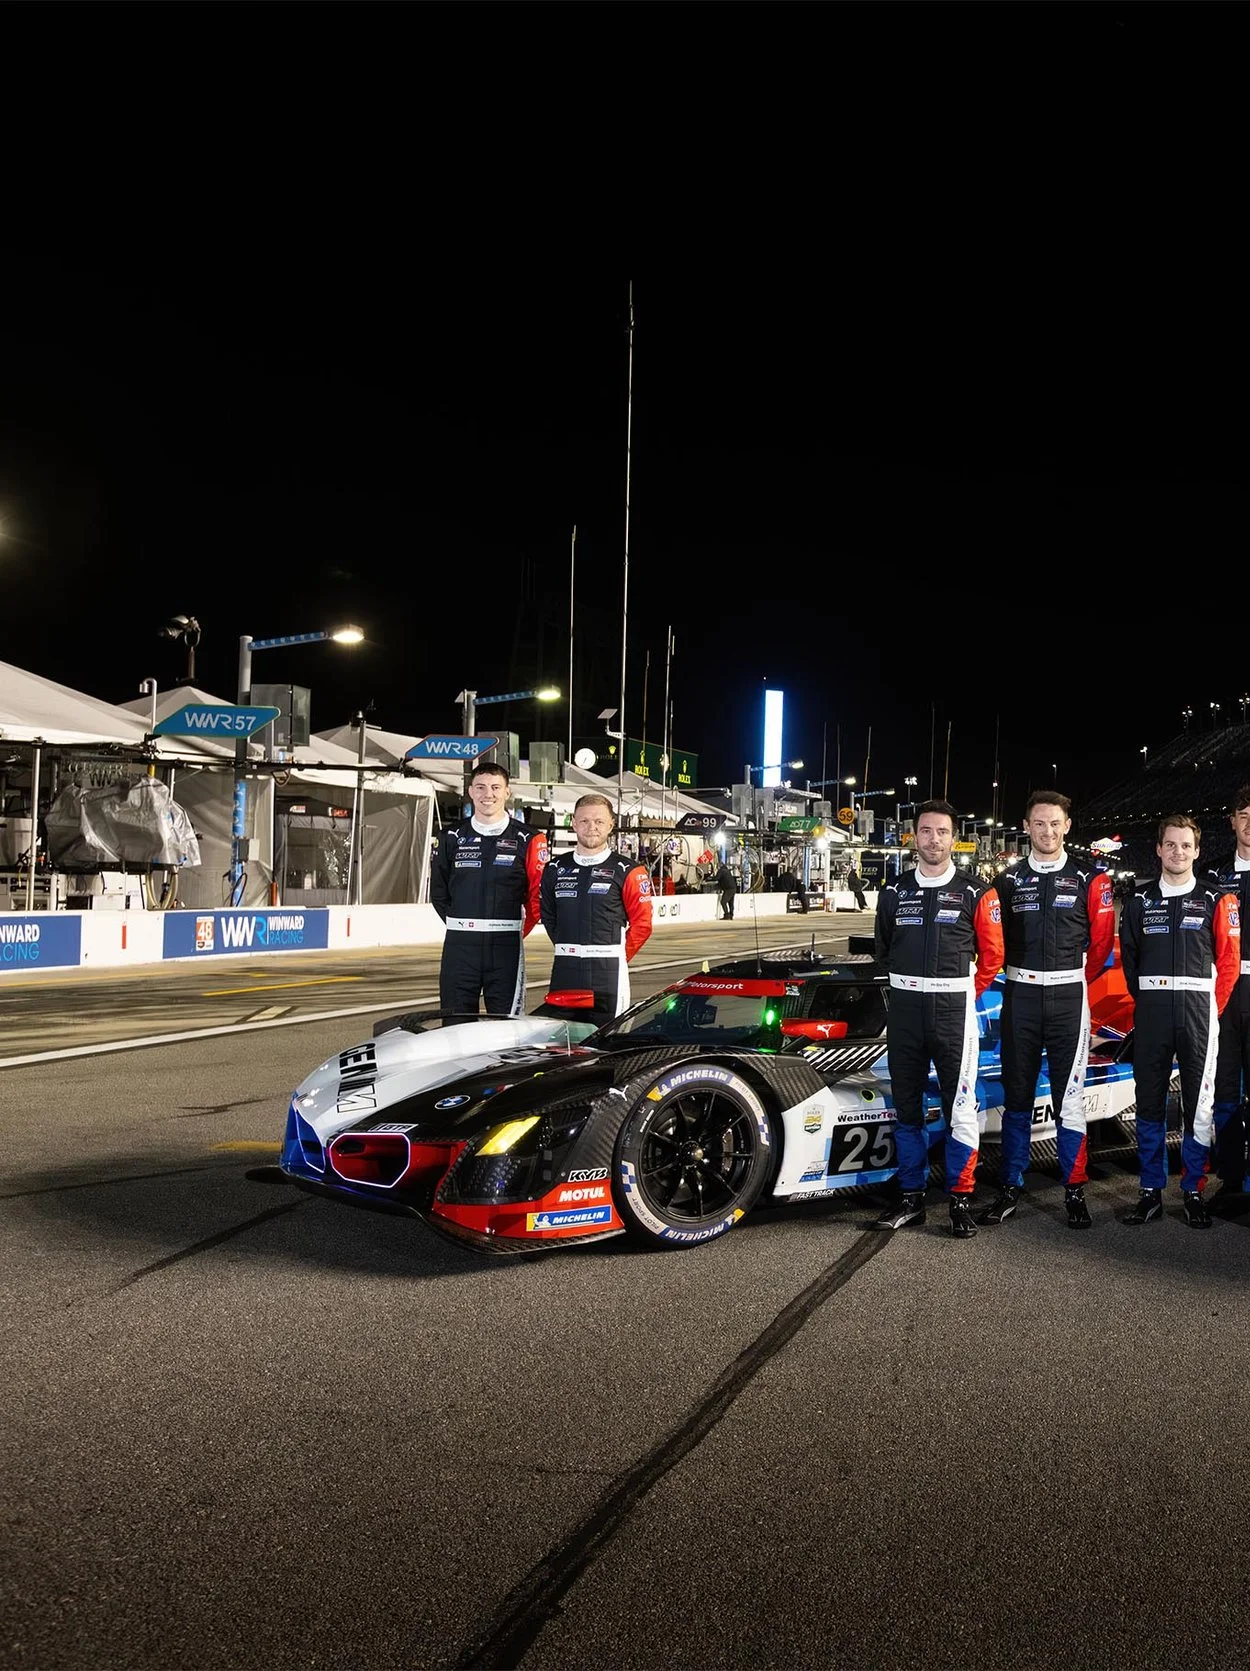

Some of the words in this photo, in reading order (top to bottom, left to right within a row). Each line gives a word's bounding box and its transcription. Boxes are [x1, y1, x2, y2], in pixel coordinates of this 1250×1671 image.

[234, 716, 256, 731] 57
[462, 743, 479, 755] 48
[677, 773, 692, 785] ROLEX
[702, 817, 717, 828] 99
[839, 810, 854, 822] 59
[800, 820, 812, 829] 77
[268, 915, 305, 931] WINWARD
[197, 922, 213, 941] 48
[269, 930, 304, 945] RACING
[670, 1069, 728, 1087] MICHELIN
[1032, 1104, 1056, 1125] EN
[838, 1125, 894, 1172] 25
[567, 1167, 608, 1182] KYB
[558, 1186, 606, 1202] MOTUL
[552, 1211, 606, 1225] MICHELIN
[666, 1222, 725, 1241] MICHELIN
